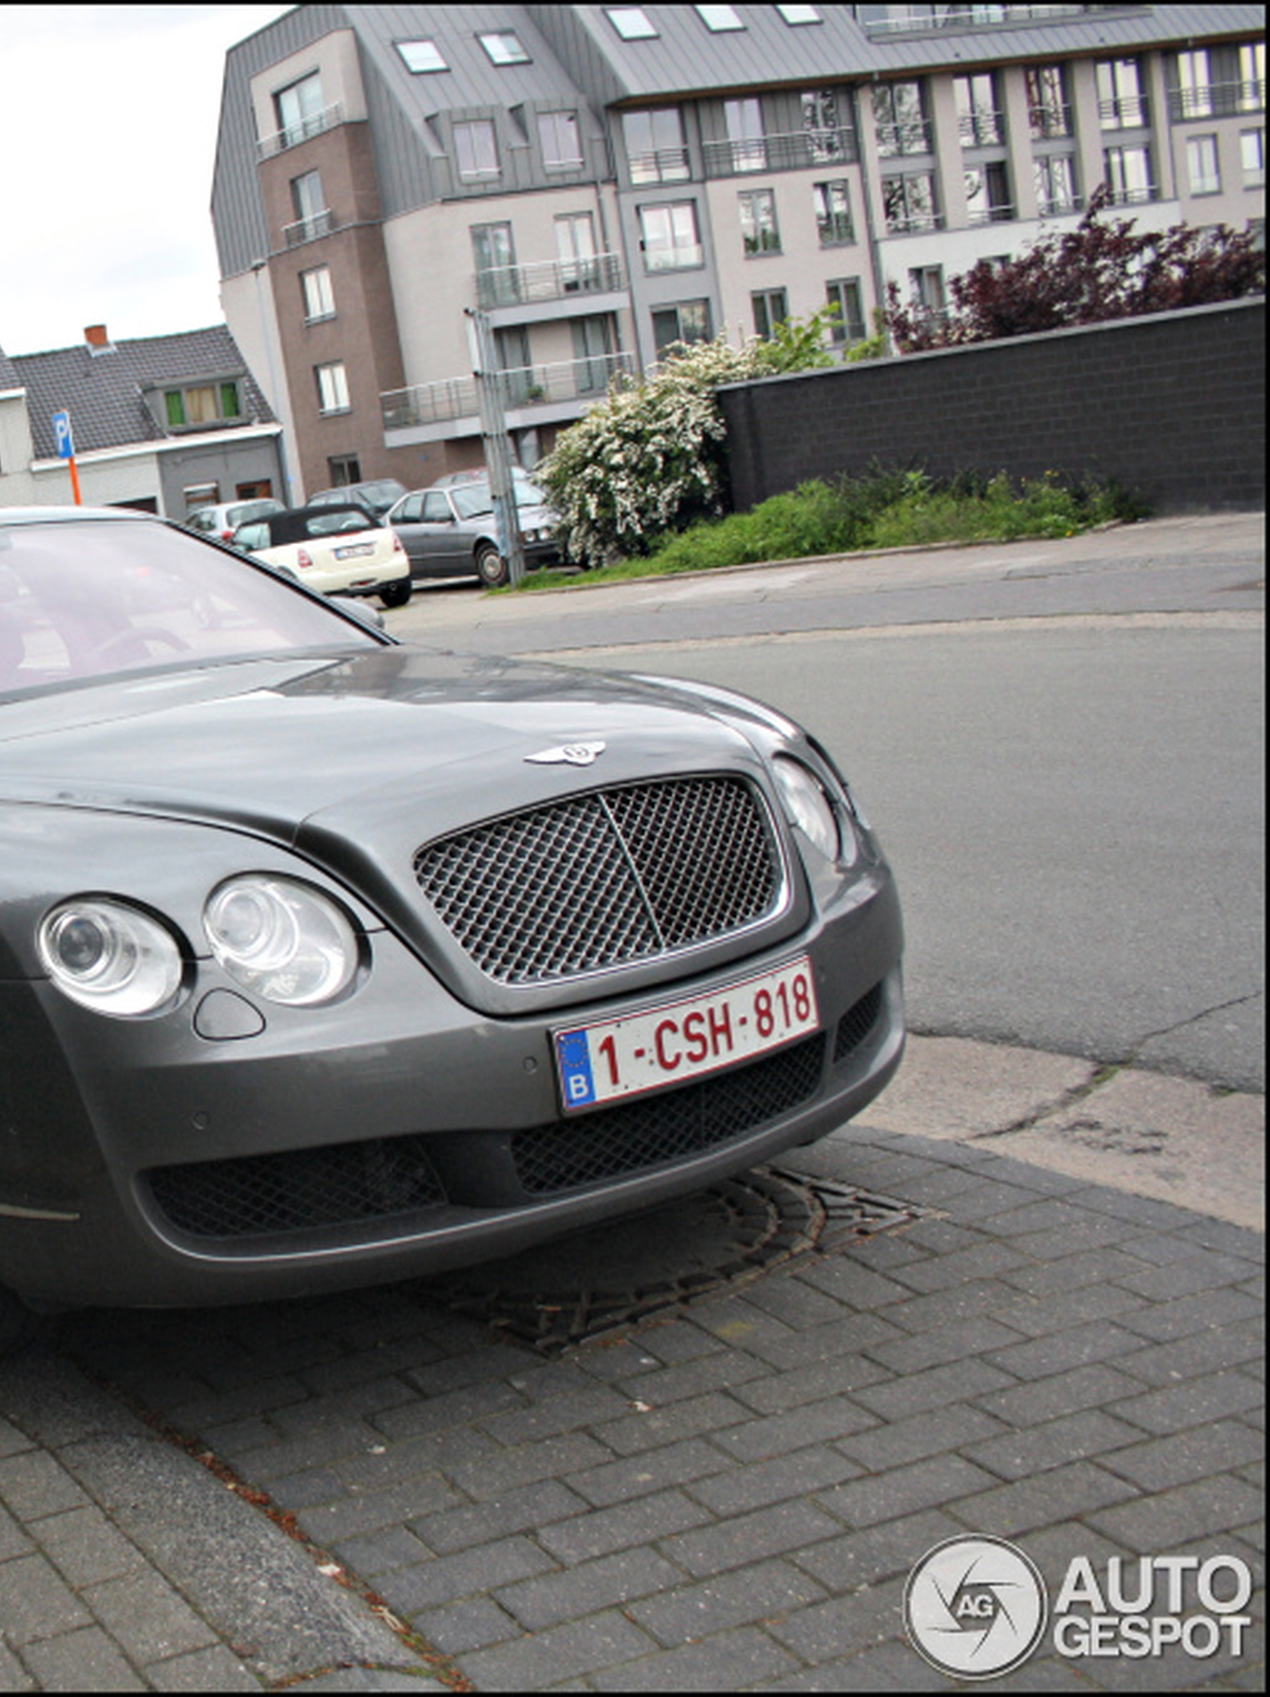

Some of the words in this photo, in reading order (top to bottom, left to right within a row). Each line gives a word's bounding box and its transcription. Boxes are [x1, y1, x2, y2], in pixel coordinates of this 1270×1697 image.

[56, 419, 68, 452] P
[598, 973, 811, 1086] 1-CSH-818
[568, 1073, 589, 1100] B
